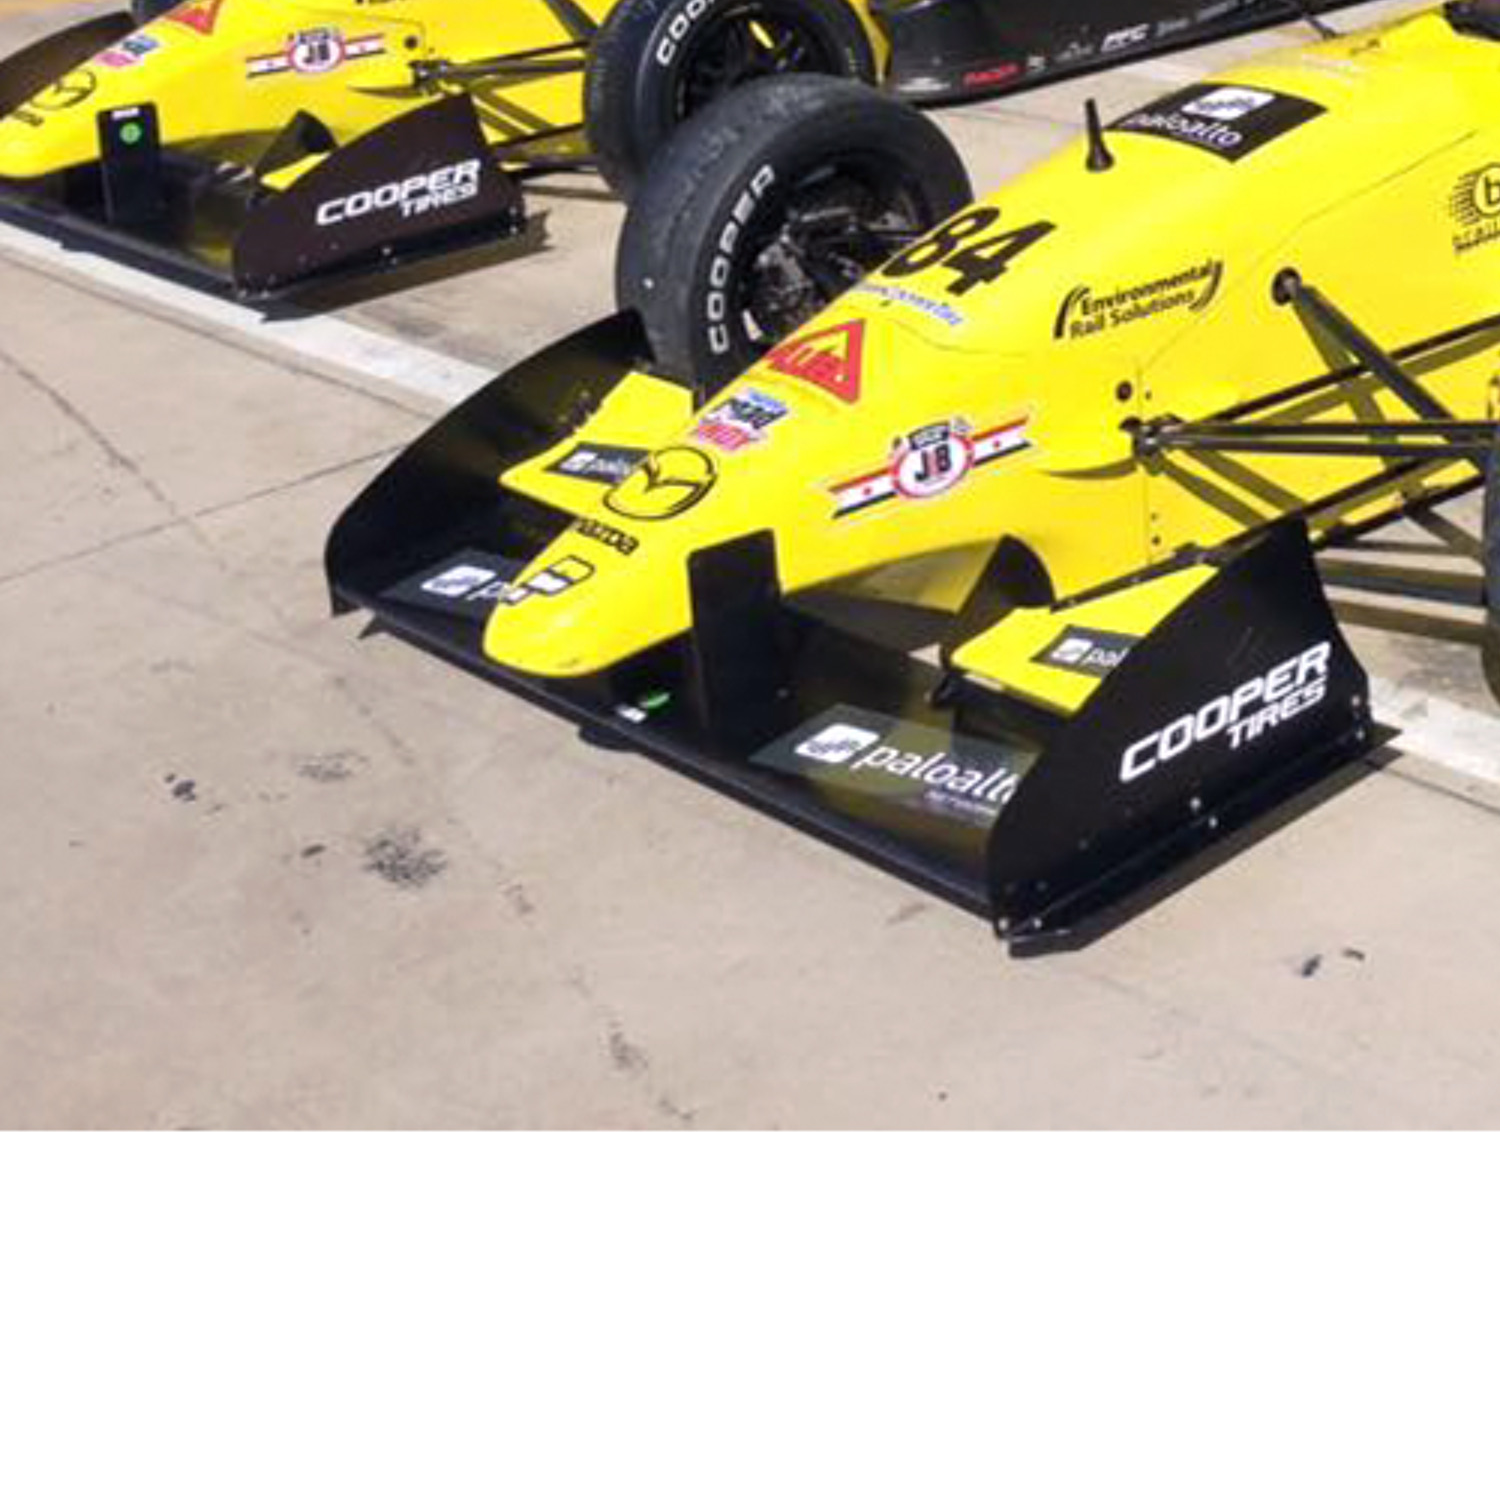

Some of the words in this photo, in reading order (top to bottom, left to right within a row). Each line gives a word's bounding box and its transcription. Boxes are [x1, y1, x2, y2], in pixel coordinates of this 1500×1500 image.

[315, 158, 482, 226] COOPER
[705, 163, 776, 355] COOPER
[882, 206, 1057, 297] 84
[1082, 257, 1214, 315] Environmental
[1070, 313, 1105, 339] Rail
[1110, 289, 1195, 327] Solutions
[1118, 641, 1332, 783] COOPER
[1226, 674, 1328, 749] TIRES
